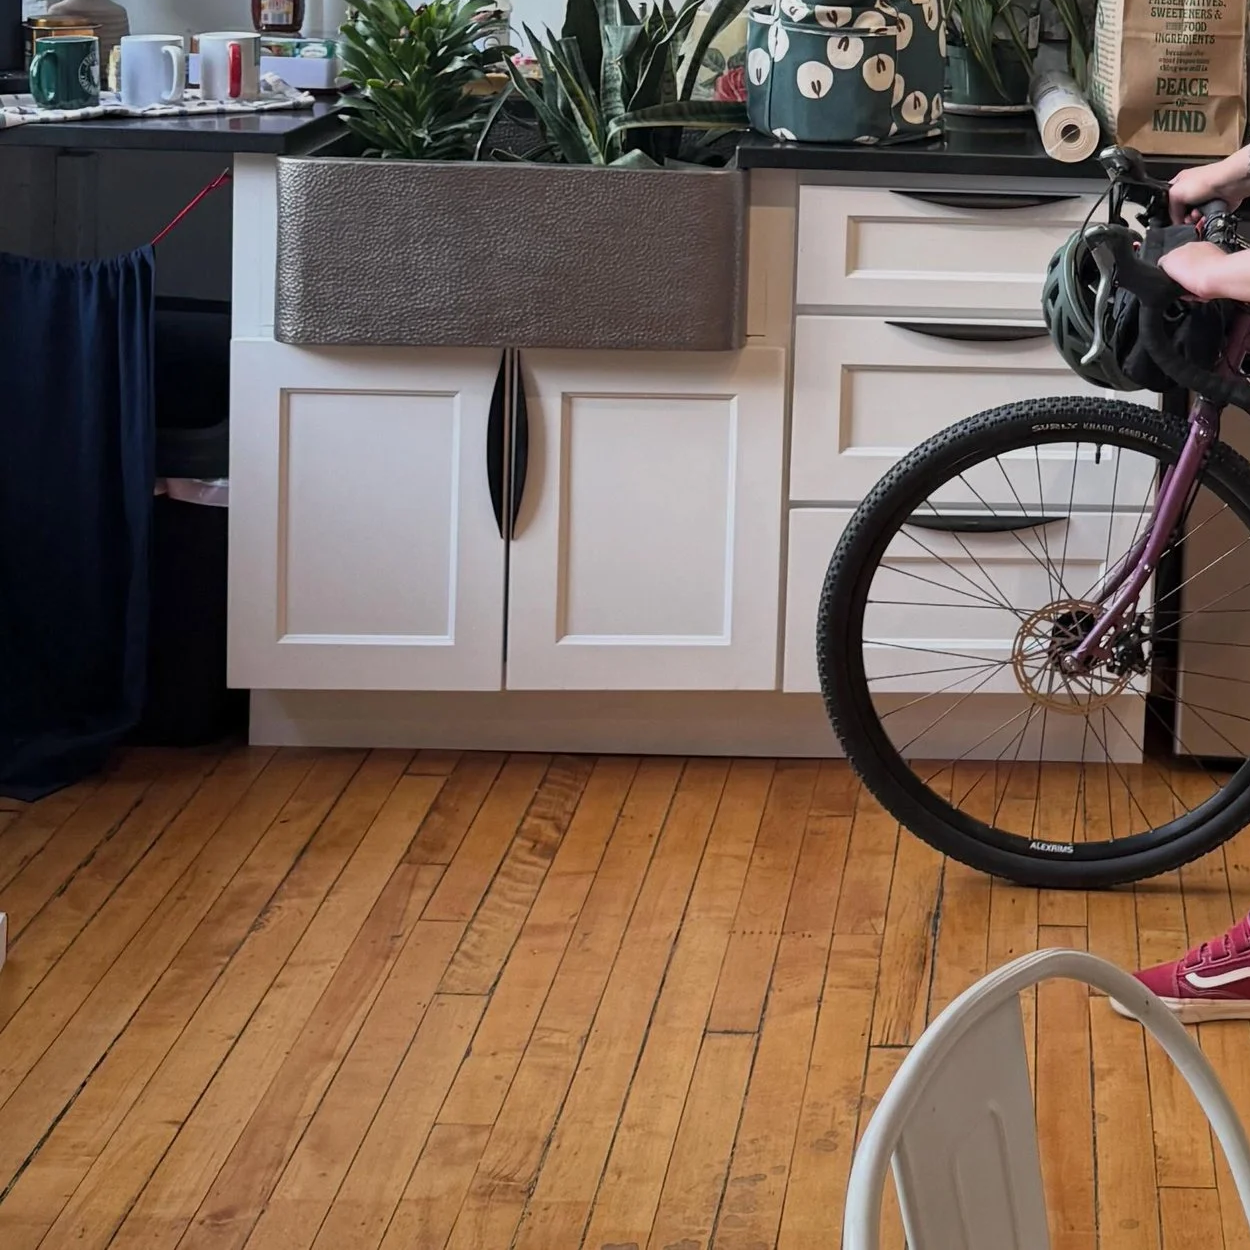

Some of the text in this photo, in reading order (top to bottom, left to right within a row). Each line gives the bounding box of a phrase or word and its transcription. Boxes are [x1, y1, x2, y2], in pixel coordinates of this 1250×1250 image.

[1150, 7, 1223, 20] SWEETENERS &
[1183, 21, 1208, 32] FOOD
[1154, 32, 1216, 45] INGREDIENTS
[1155, 77, 1209, 97] PEACE
[1152, 109, 1207, 133] MIND
[1031, 422, 1079, 432] SURLY
